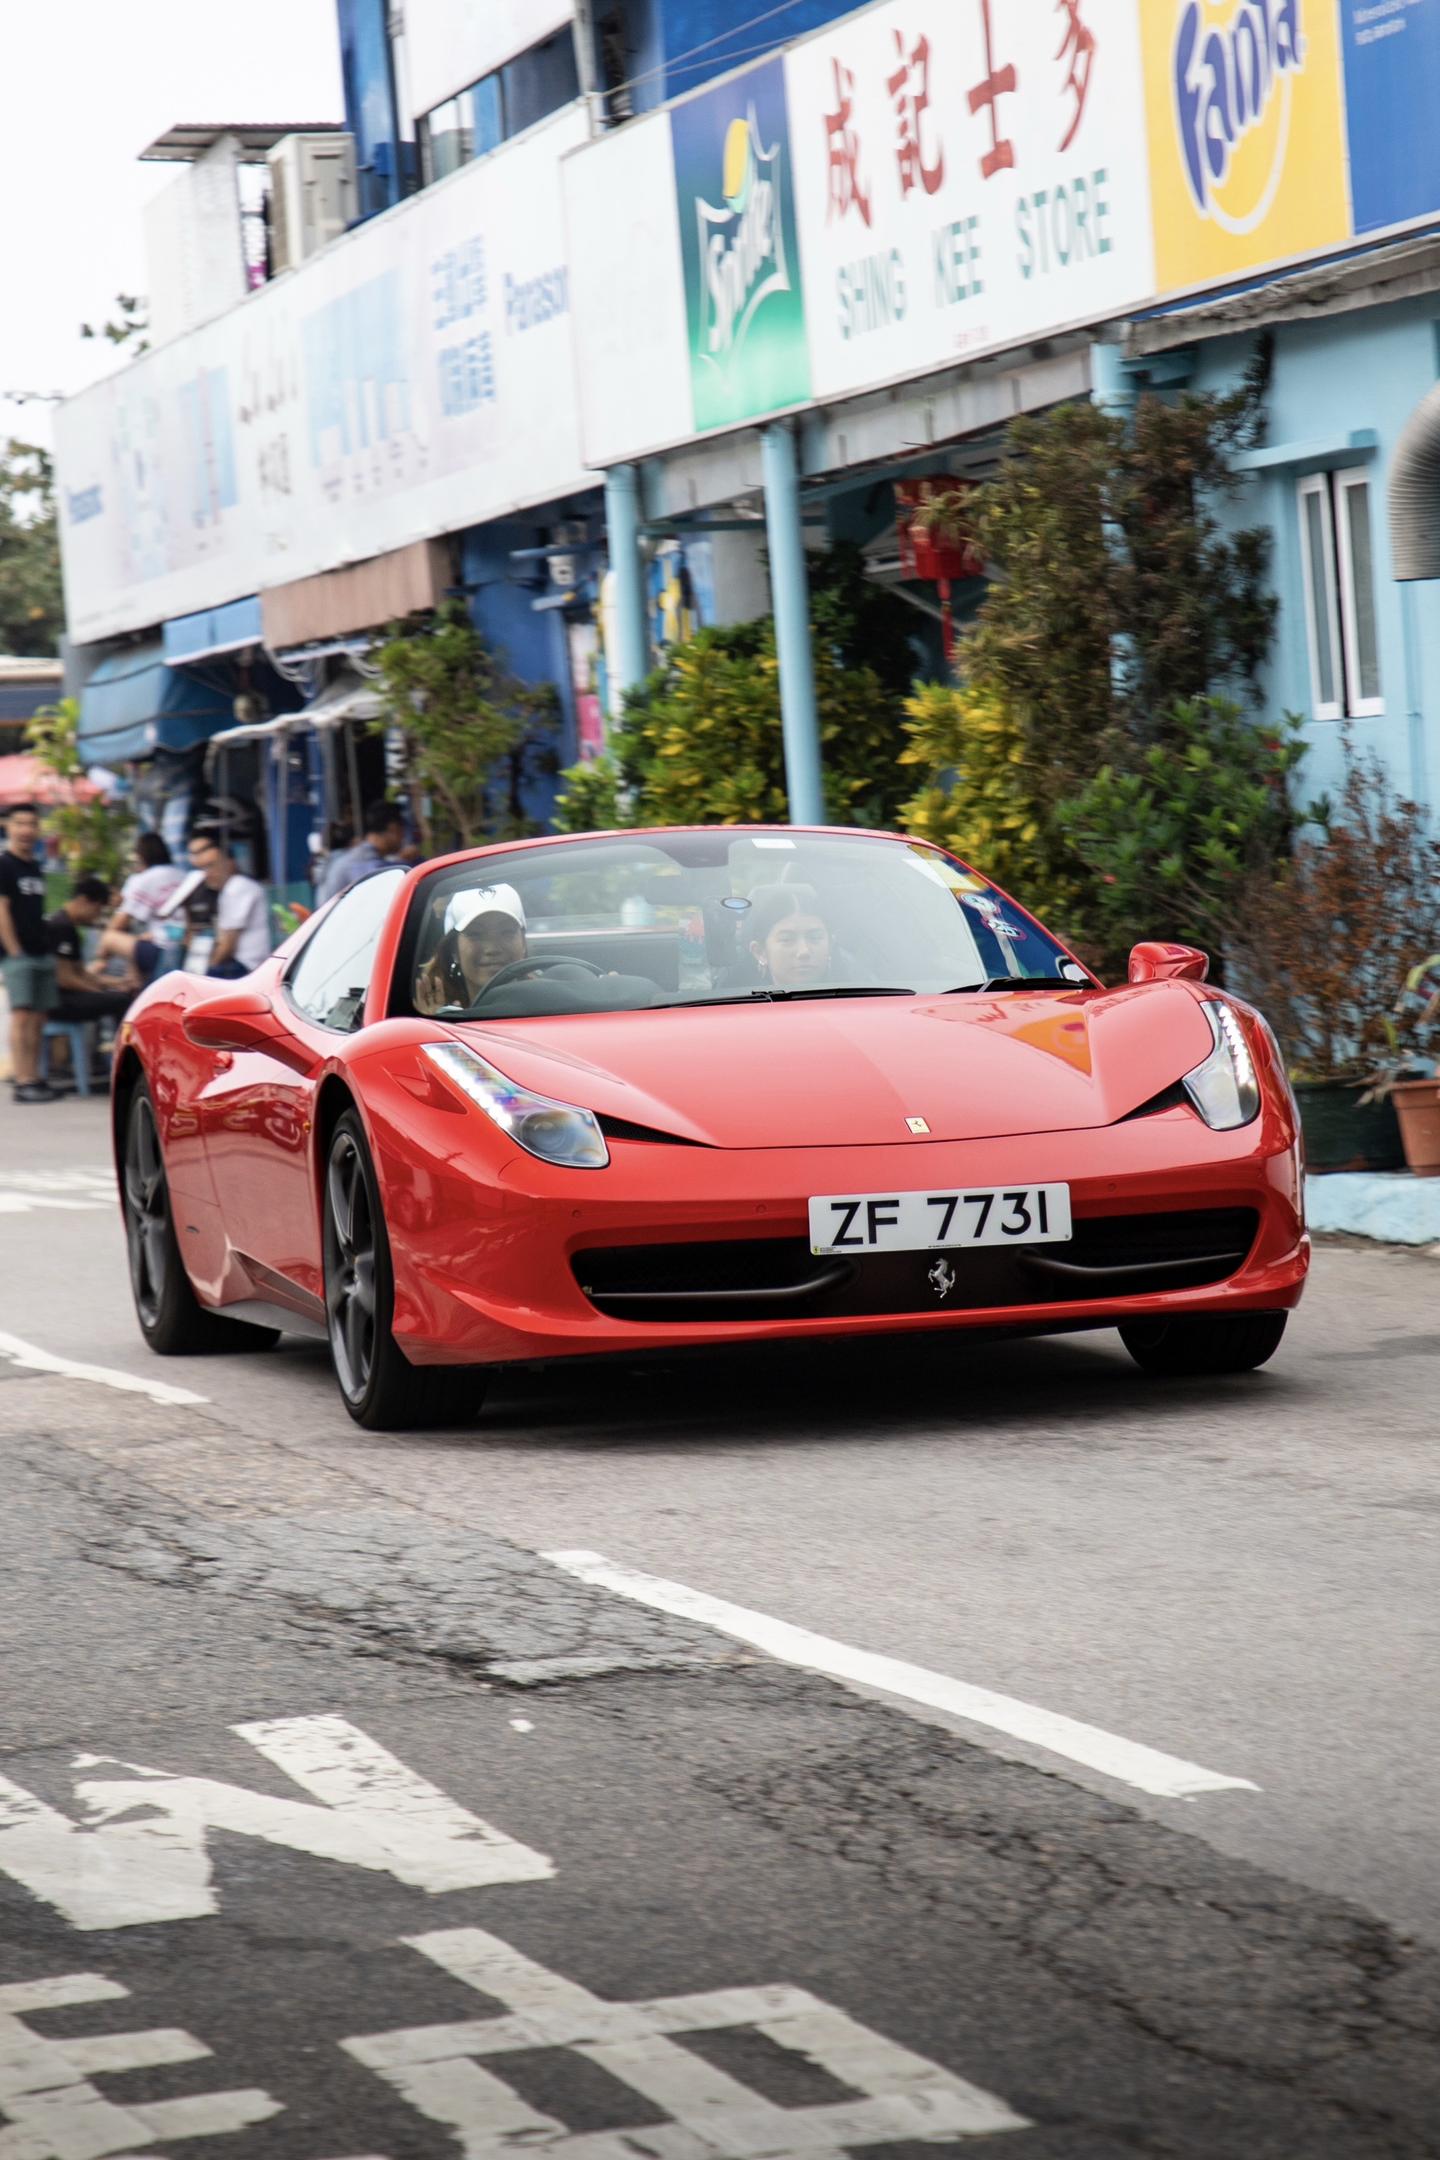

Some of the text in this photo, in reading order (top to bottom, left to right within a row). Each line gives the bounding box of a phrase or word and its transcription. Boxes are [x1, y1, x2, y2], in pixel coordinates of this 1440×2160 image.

[823, 0, 1098, 230] 成記士多
[1175, 0, 1303, 212] Fanta
[836, 168, 1113, 341] SHING KEE STORE
[830, 1190, 1050, 1247] ZF 7731
